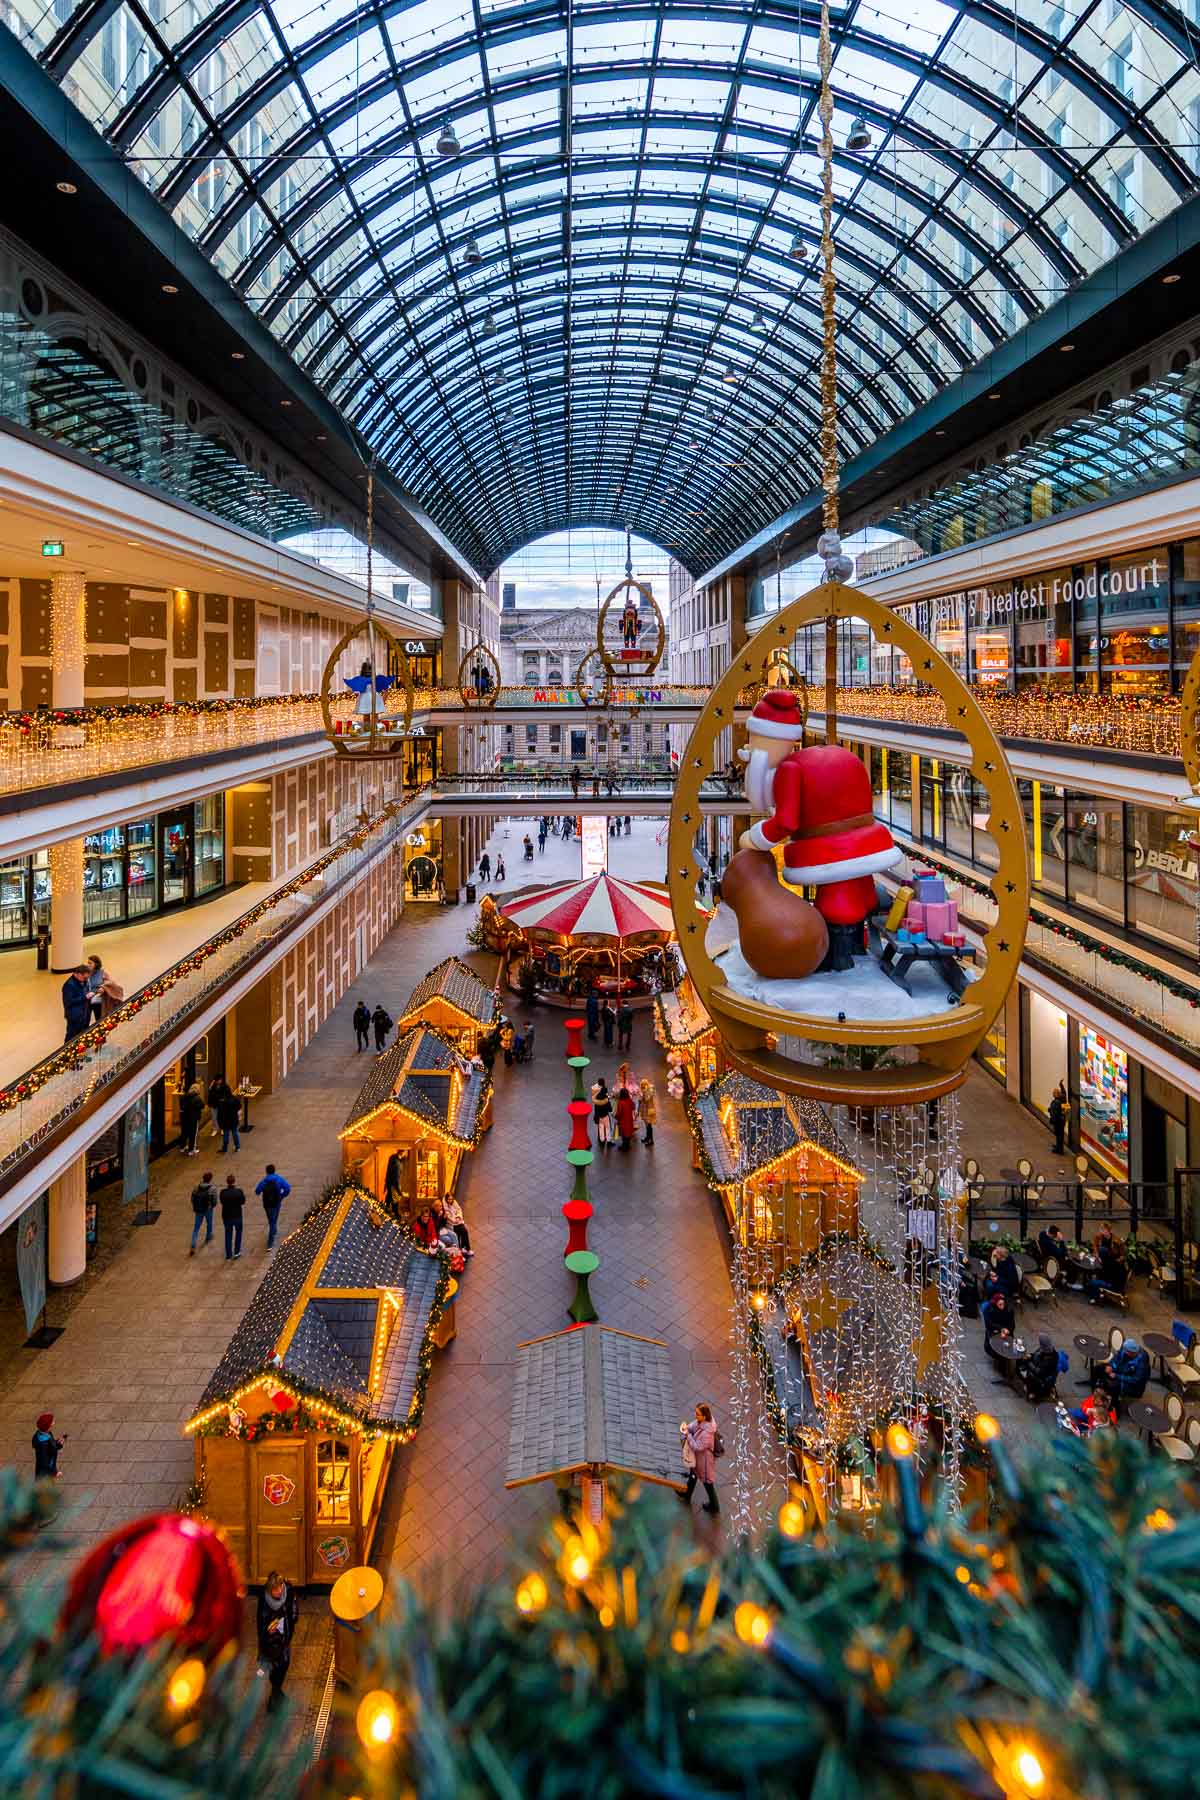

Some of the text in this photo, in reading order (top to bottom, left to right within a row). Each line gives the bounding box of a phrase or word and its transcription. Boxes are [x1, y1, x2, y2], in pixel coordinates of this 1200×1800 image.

[983, 582, 1044, 620] greatest
[1053, 558, 1160, 605] Foodcourt
[981, 659, 1006, 667] SALE
[533, 690, 575, 702] MALL
